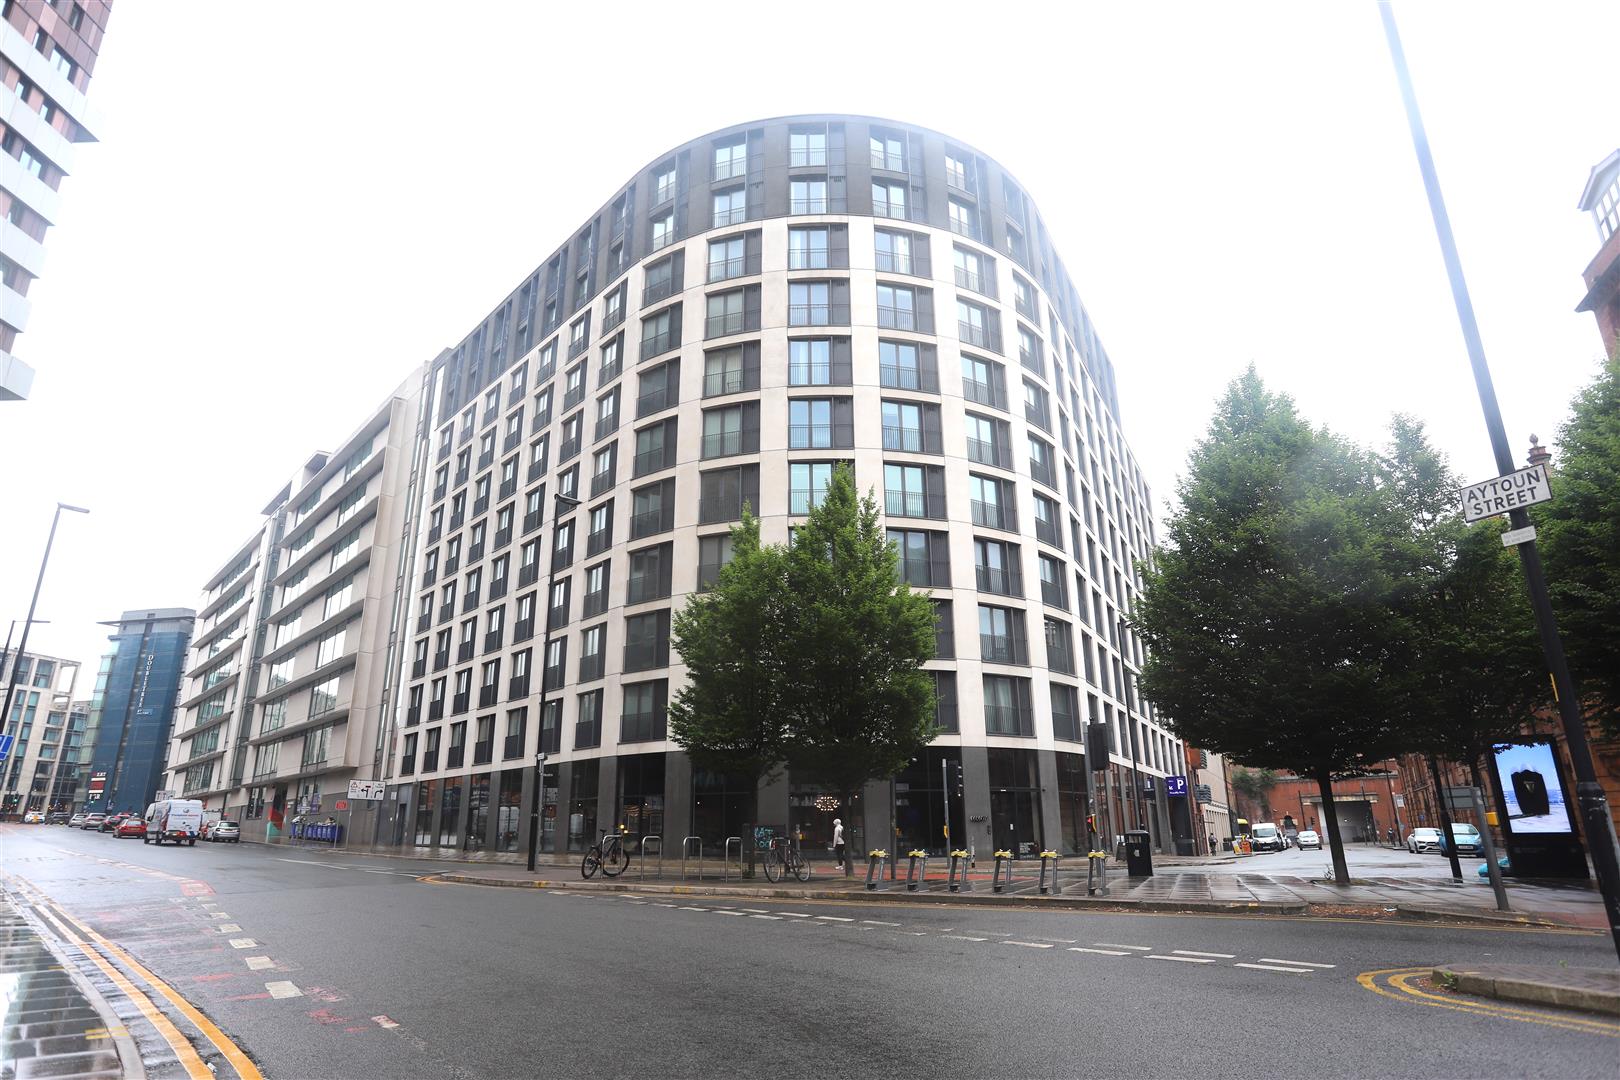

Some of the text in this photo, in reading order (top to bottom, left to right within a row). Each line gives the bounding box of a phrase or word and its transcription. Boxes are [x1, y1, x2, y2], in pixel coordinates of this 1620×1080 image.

[1467, 469, 1541, 503] AYTOUN
[1473, 486, 1538, 516] STREET
[1177, 779, 1184, 790] P
